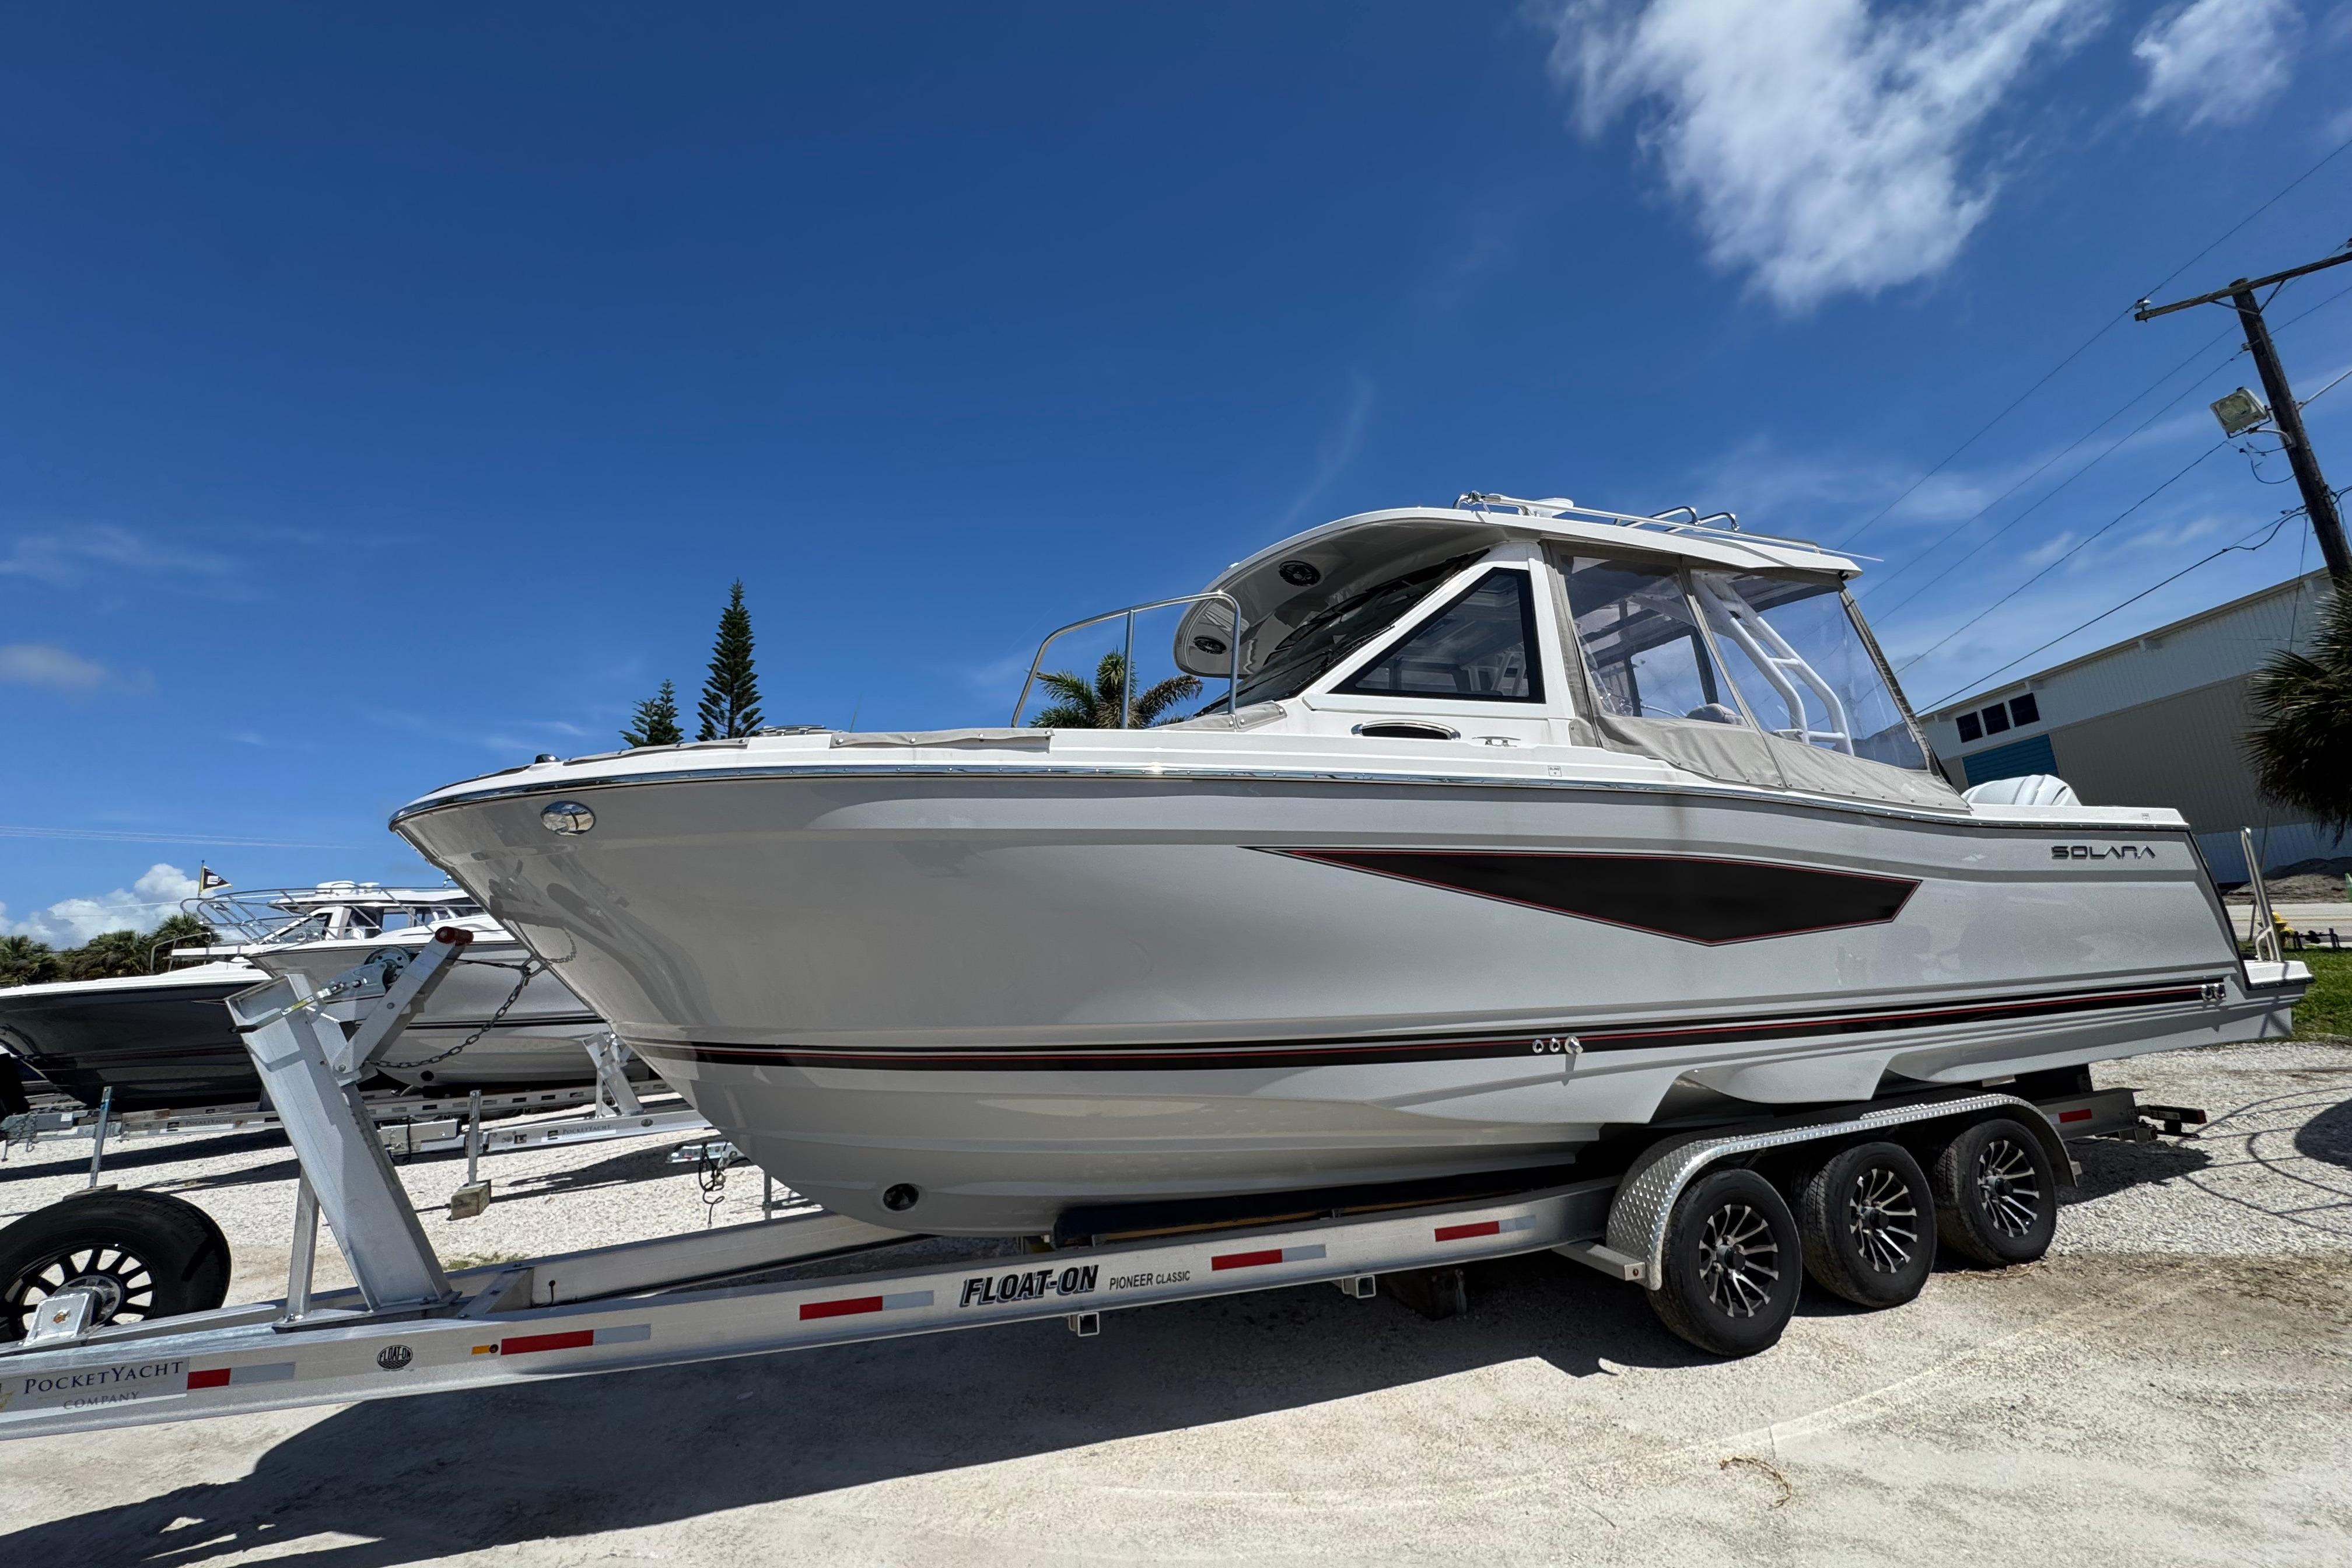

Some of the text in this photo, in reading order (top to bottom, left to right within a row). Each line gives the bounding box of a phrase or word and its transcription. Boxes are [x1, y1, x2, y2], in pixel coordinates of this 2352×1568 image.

[959, 1265, 1191, 1307] FLOAT-ON PIONEER CLASSIC
[379, 1346, 412, 1362] FLOAT-ON
[64, 1391, 139, 1410] COMPANY
